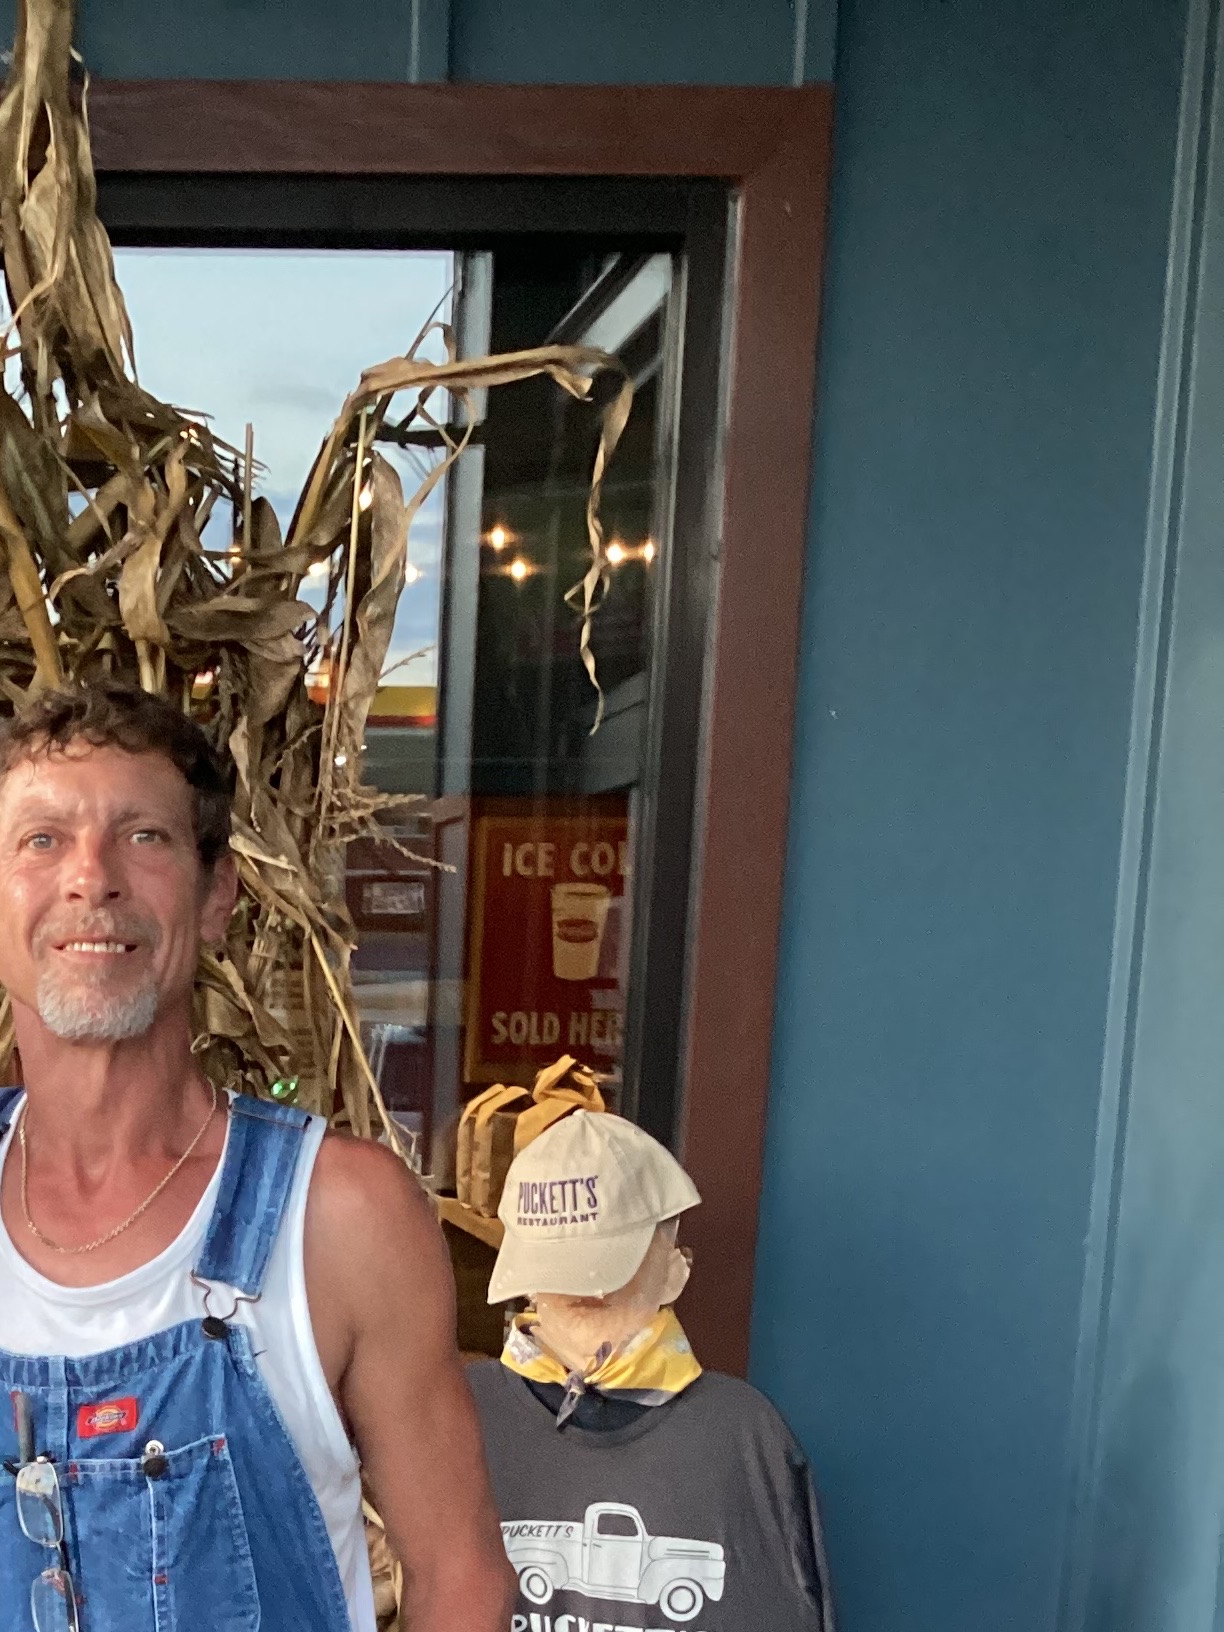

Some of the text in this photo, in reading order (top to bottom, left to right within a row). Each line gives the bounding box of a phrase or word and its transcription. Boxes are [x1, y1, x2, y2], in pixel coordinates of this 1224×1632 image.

[502, 841, 635, 877] ICE COL
[490, 1011, 624, 1046] SOLD HER
[517, 1176, 598, 1214] PUCKETT'S
[517, 1212, 598, 1226] RESTAURANT
[502, 1524, 574, 1538] PUCKETT'S
